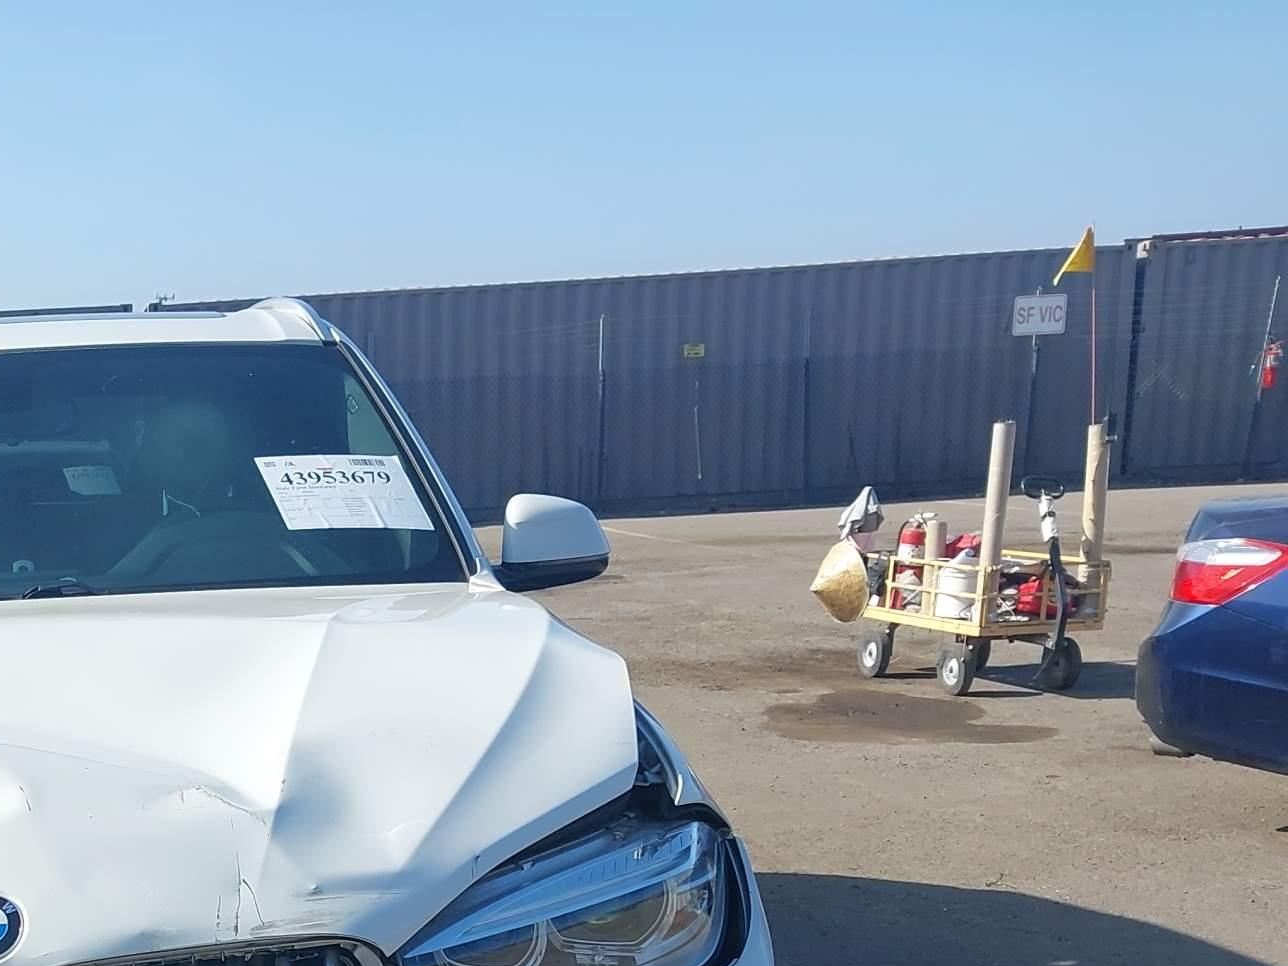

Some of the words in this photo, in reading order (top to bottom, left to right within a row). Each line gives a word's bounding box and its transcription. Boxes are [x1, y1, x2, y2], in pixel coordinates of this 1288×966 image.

[1016, 306, 1036, 325] SF
[1039, 304, 1064, 324] VIC
[280, 470, 392, 486] 43953679
